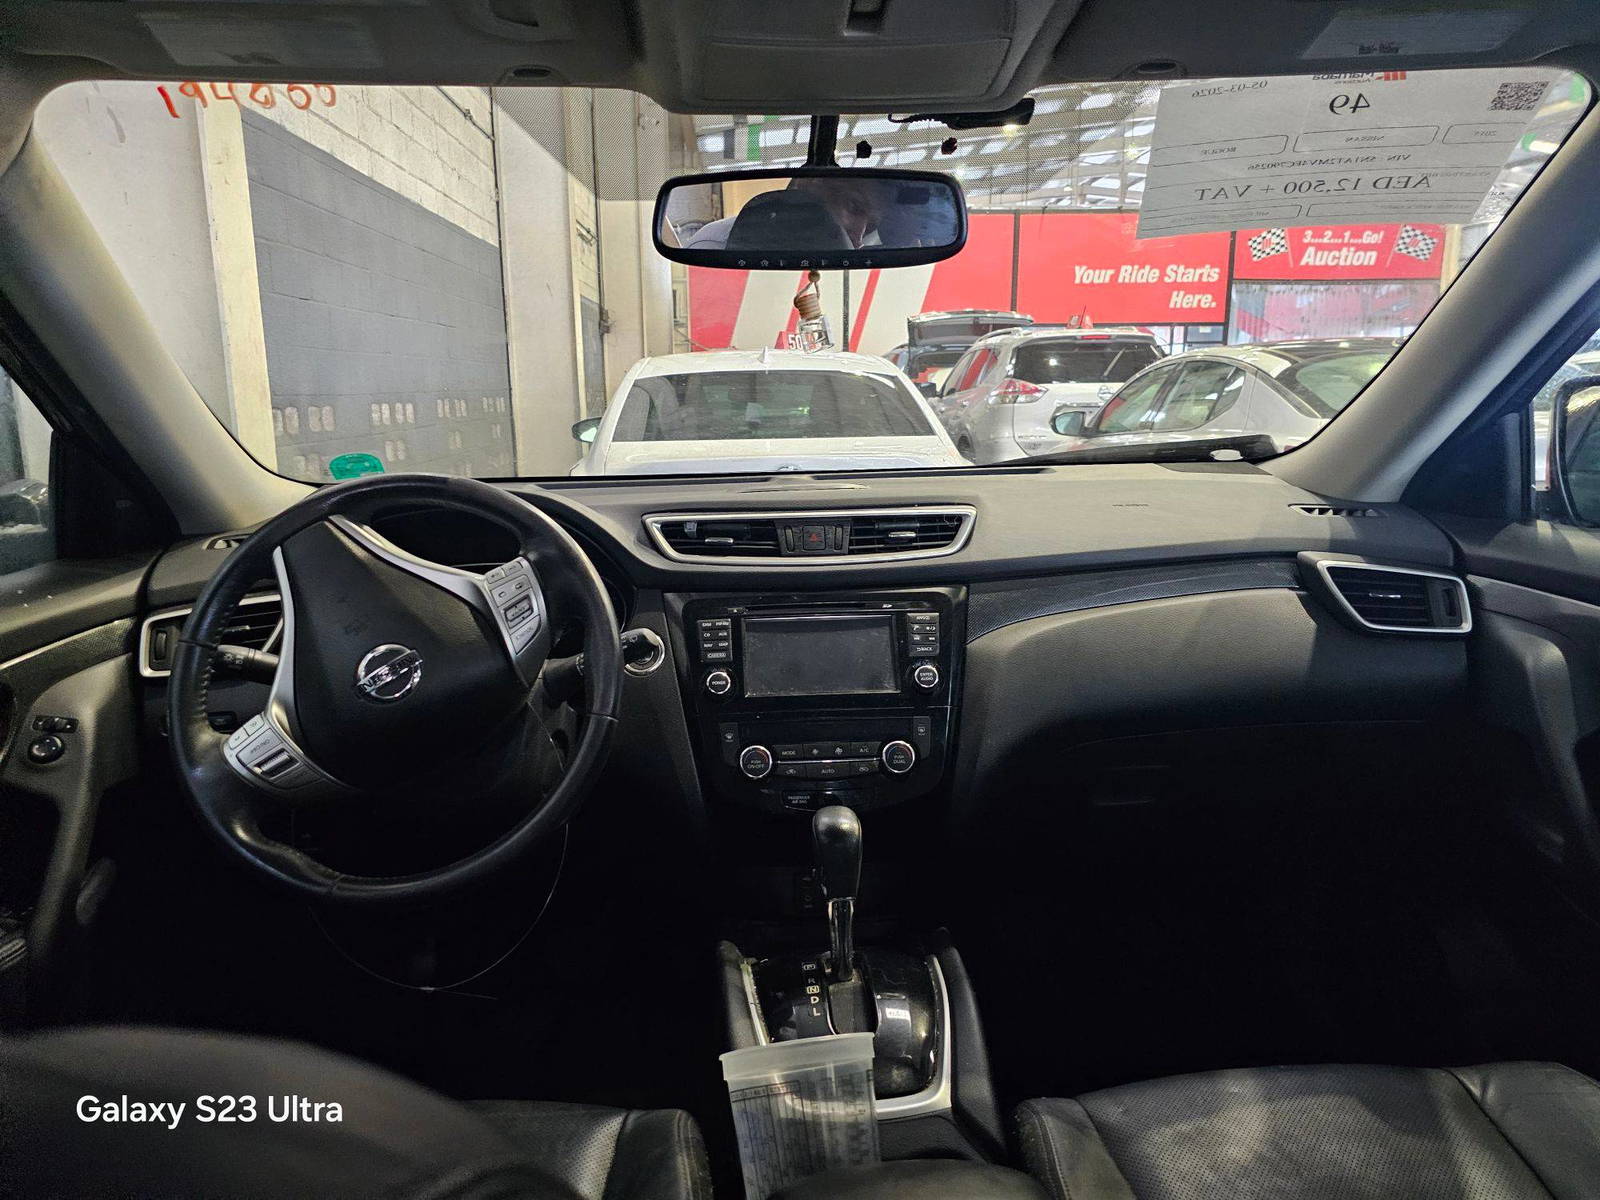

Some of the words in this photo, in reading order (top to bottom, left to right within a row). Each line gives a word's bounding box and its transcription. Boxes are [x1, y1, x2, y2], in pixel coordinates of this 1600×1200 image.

[1300, 246, 1378, 266] Auction
[1074, 264, 1115, 284] Your
[1117, 264, 1160, 284] Ride
[1163, 264, 1221, 284] Starts
[1168, 290, 1217, 309] Here.
[811, 996, 820, 1004] D
[813, 1008, 821, 1017] L
